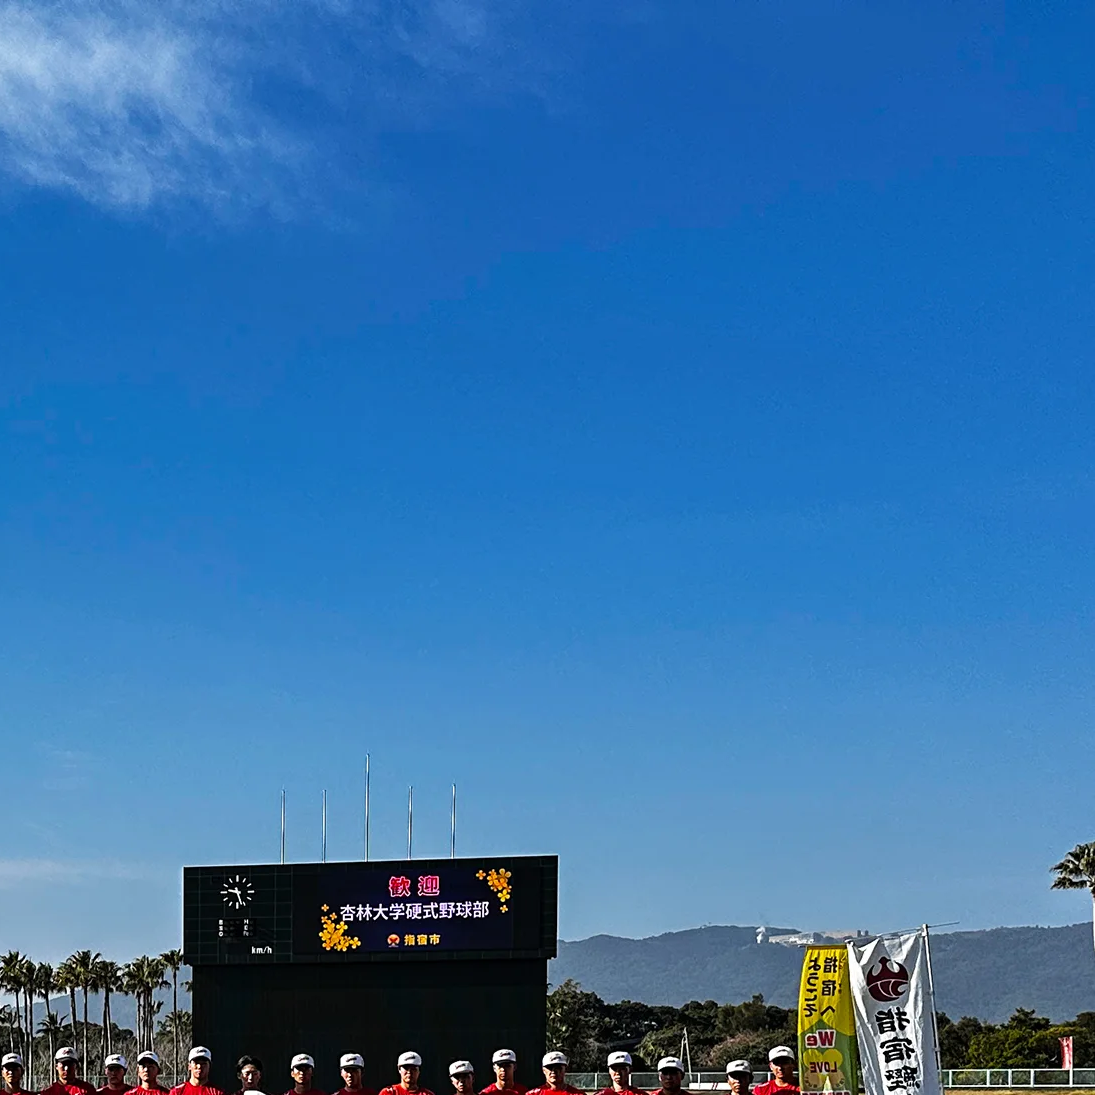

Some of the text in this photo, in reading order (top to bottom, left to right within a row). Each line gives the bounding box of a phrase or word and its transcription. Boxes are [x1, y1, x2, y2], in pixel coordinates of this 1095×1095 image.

[388, 876, 440, 897] 歓迎
[340, 901, 490, 921] 杏林大学硬式野球部
[404, 934, 441, 946] 指宿市
[251, 946, 273, 954] km/h
